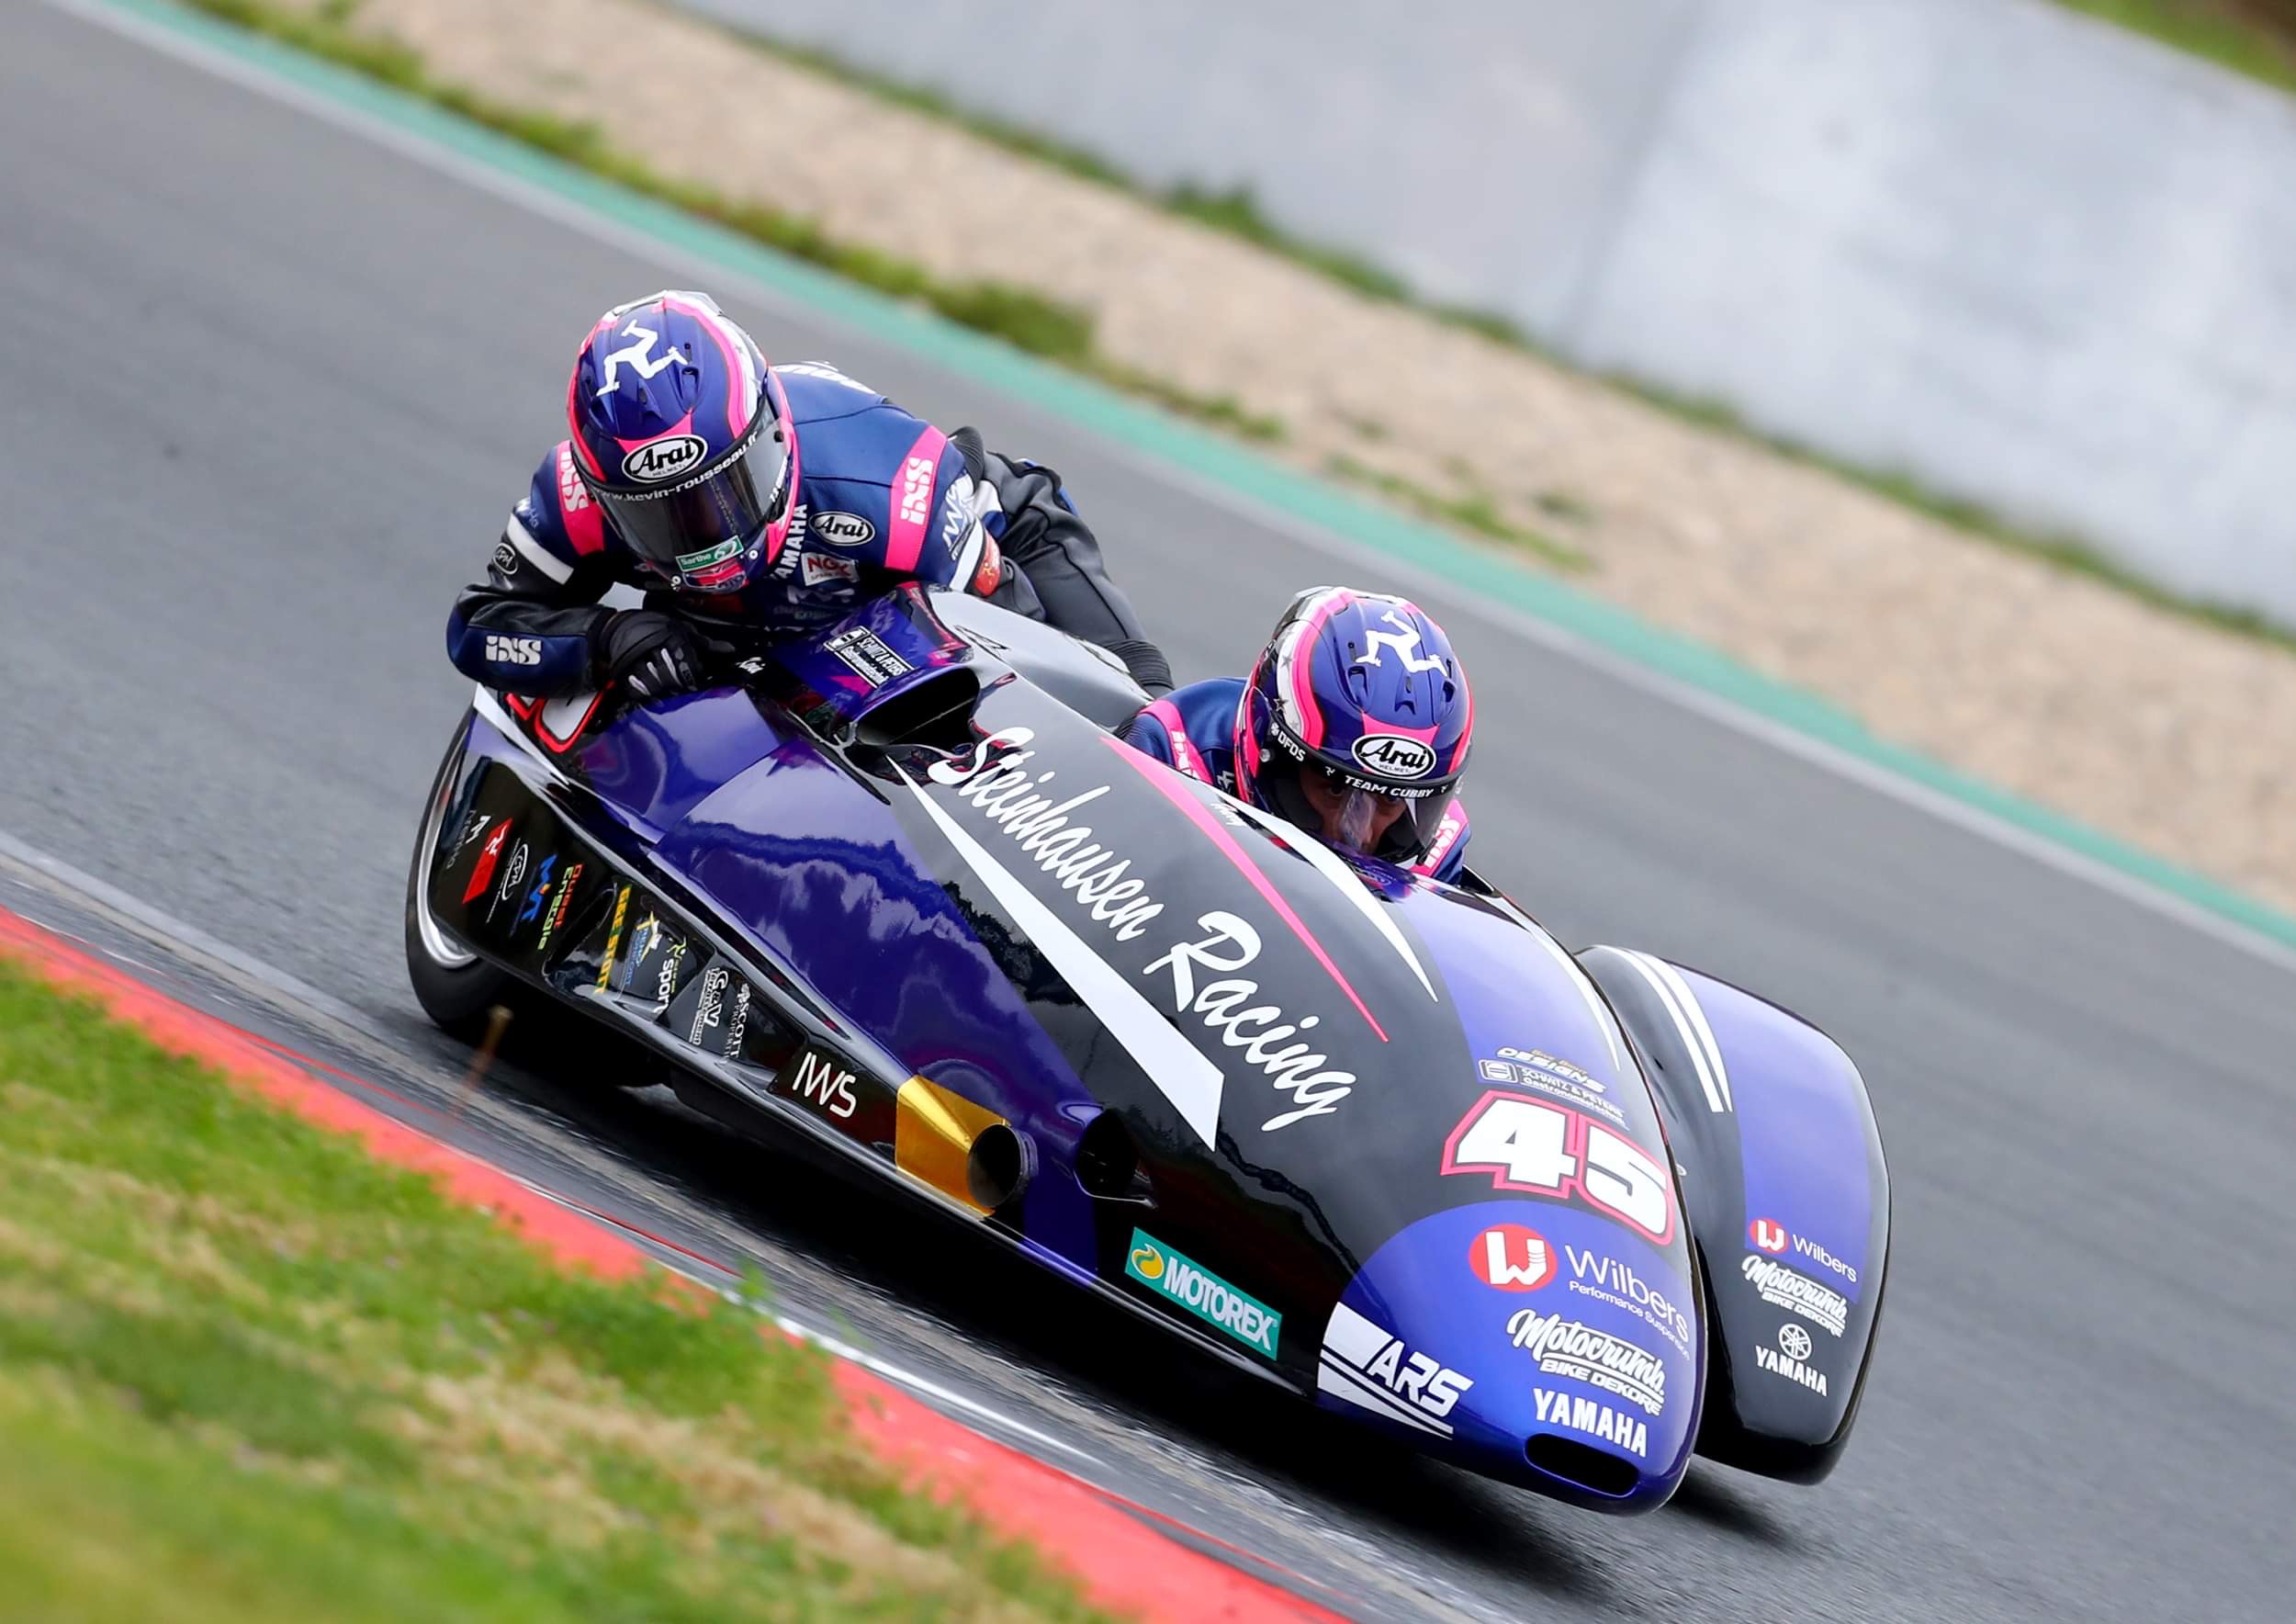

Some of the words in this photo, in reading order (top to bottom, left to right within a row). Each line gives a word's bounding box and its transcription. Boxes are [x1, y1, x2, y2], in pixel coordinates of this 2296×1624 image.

[630, 439, 694, 476] Arai
[814, 515, 866, 537] Arai
[680, 552, 713, 566] Sarthe
[1277, 730, 1306, 762] DFDS
[1358, 739, 1429, 769] Arai
[1345, 774, 1388, 795] TEAM
[1390, 786, 1435, 799] CUBBY
[926, 727, 1165, 942] Steinhausen
[729, 1001, 750, 1059] SCOTT
[1142, 910, 1357, 1132] Racing
[792, 1051, 858, 1119] IWS
[1496, 1046, 1607, 1094] DESIGNS
[1451, 1096, 1671, 1240] 45
[1792, 1234, 1858, 1283] Wilbers
[1163, 1256, 1273, 1352] MOTOREX
[1564, 1245, 1689, 1343] Wilbers
[1569, 1280, 1644, 1318] Performance
[1761, 1291, 1795, 1311] BIKE
[1366, 1338, 1475, 1418] ARS
[1539, 1358, 1592, 1382] BIKE
[1589, 1370, 1663, 1416] DEKORE
[1755, 1345, 1829, 1397] YAMAHA
[1532, 1387, 1648, 1459] YAMAHA
